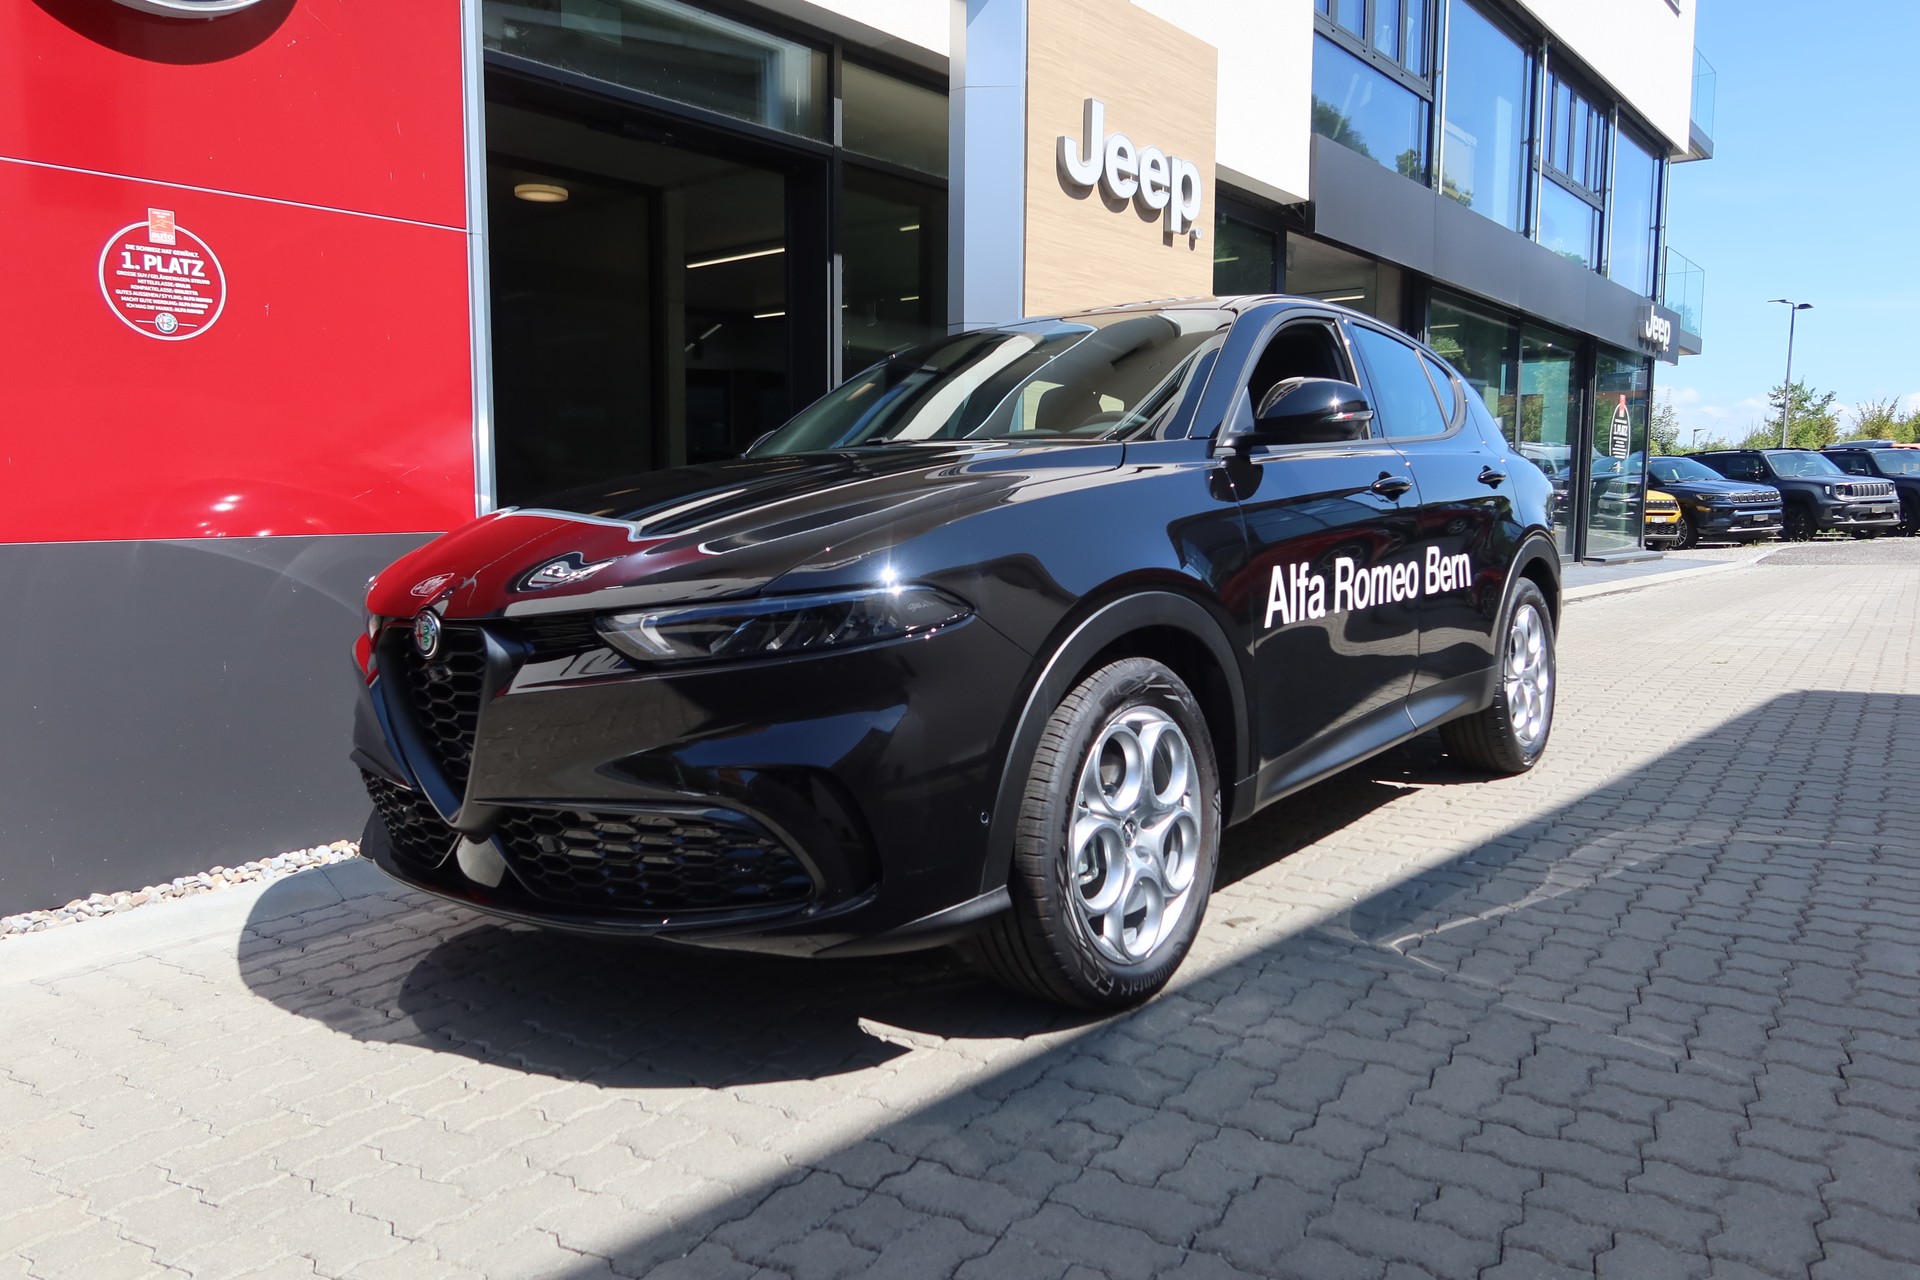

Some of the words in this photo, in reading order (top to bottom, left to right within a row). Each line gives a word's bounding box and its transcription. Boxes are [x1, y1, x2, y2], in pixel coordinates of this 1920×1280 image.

[121, 251, 140, 270] 1.
[144, 254, 205, 278] PLATZ
[1264, 562, 1326, 628] Alfa
[1334, 556, 1419, 614] Romeo
[1425, 545, 1472, 595] Bern
